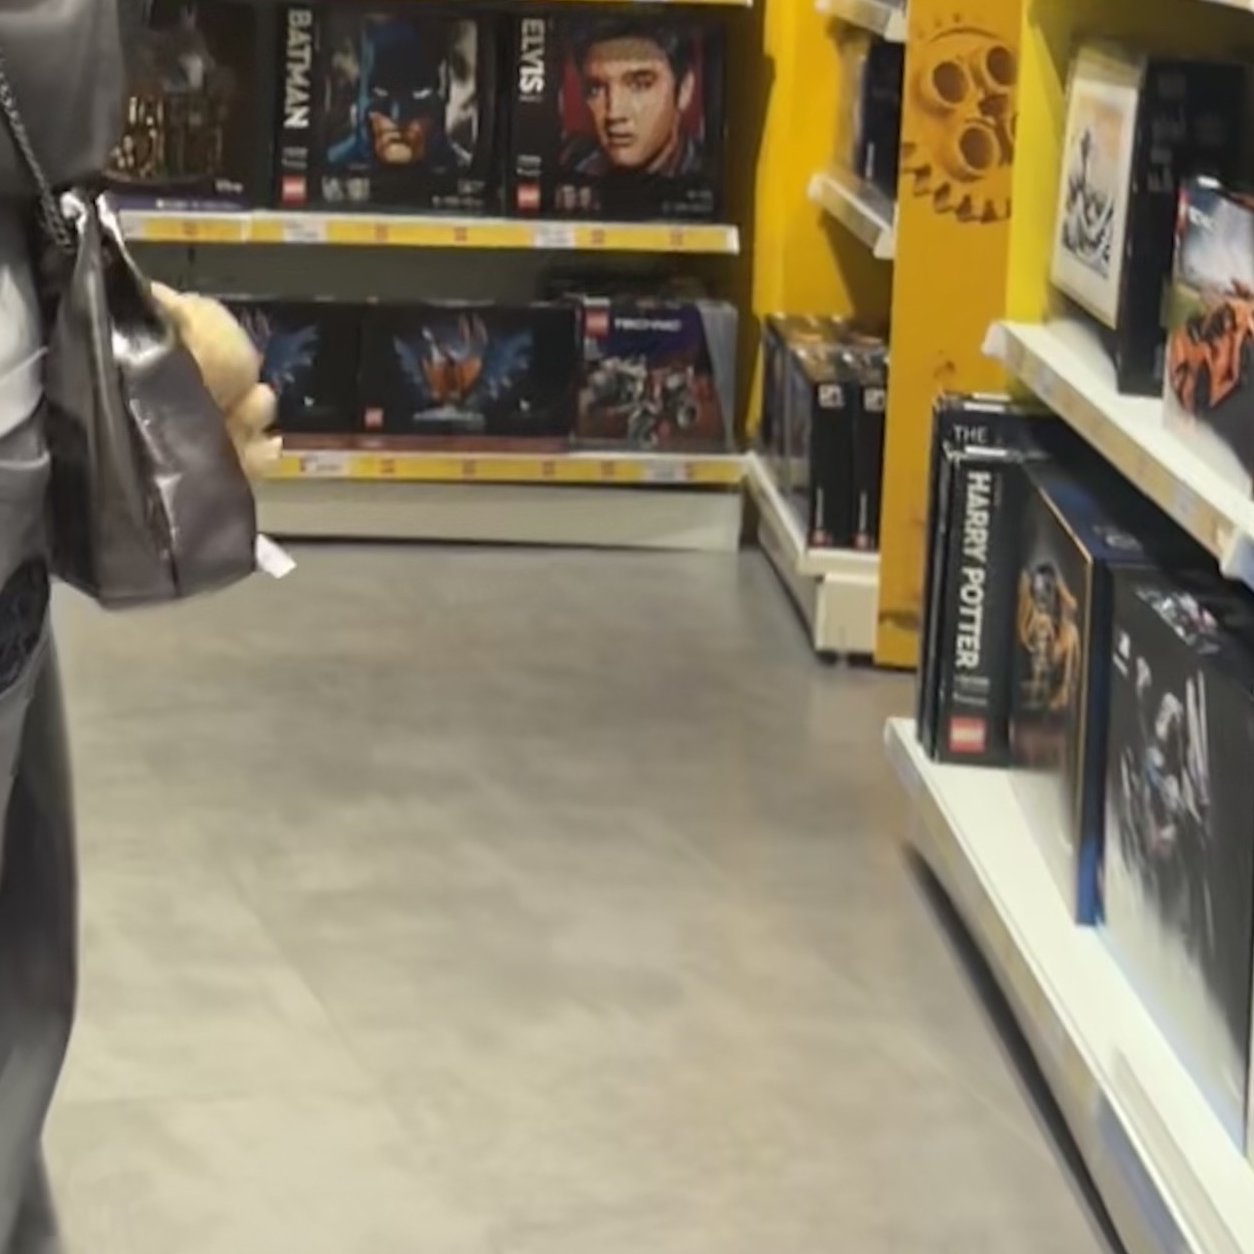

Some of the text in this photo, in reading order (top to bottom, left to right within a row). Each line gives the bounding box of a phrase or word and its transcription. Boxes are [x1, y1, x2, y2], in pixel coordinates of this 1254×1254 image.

[283, 8, 313, 130] BATMAN
[518, 18, 545, 94] ELVIS
[953, 424, 989, 444] THE
[963, 470, 991, 563] HARRY
[954, 567, 986, 670] POTTER
